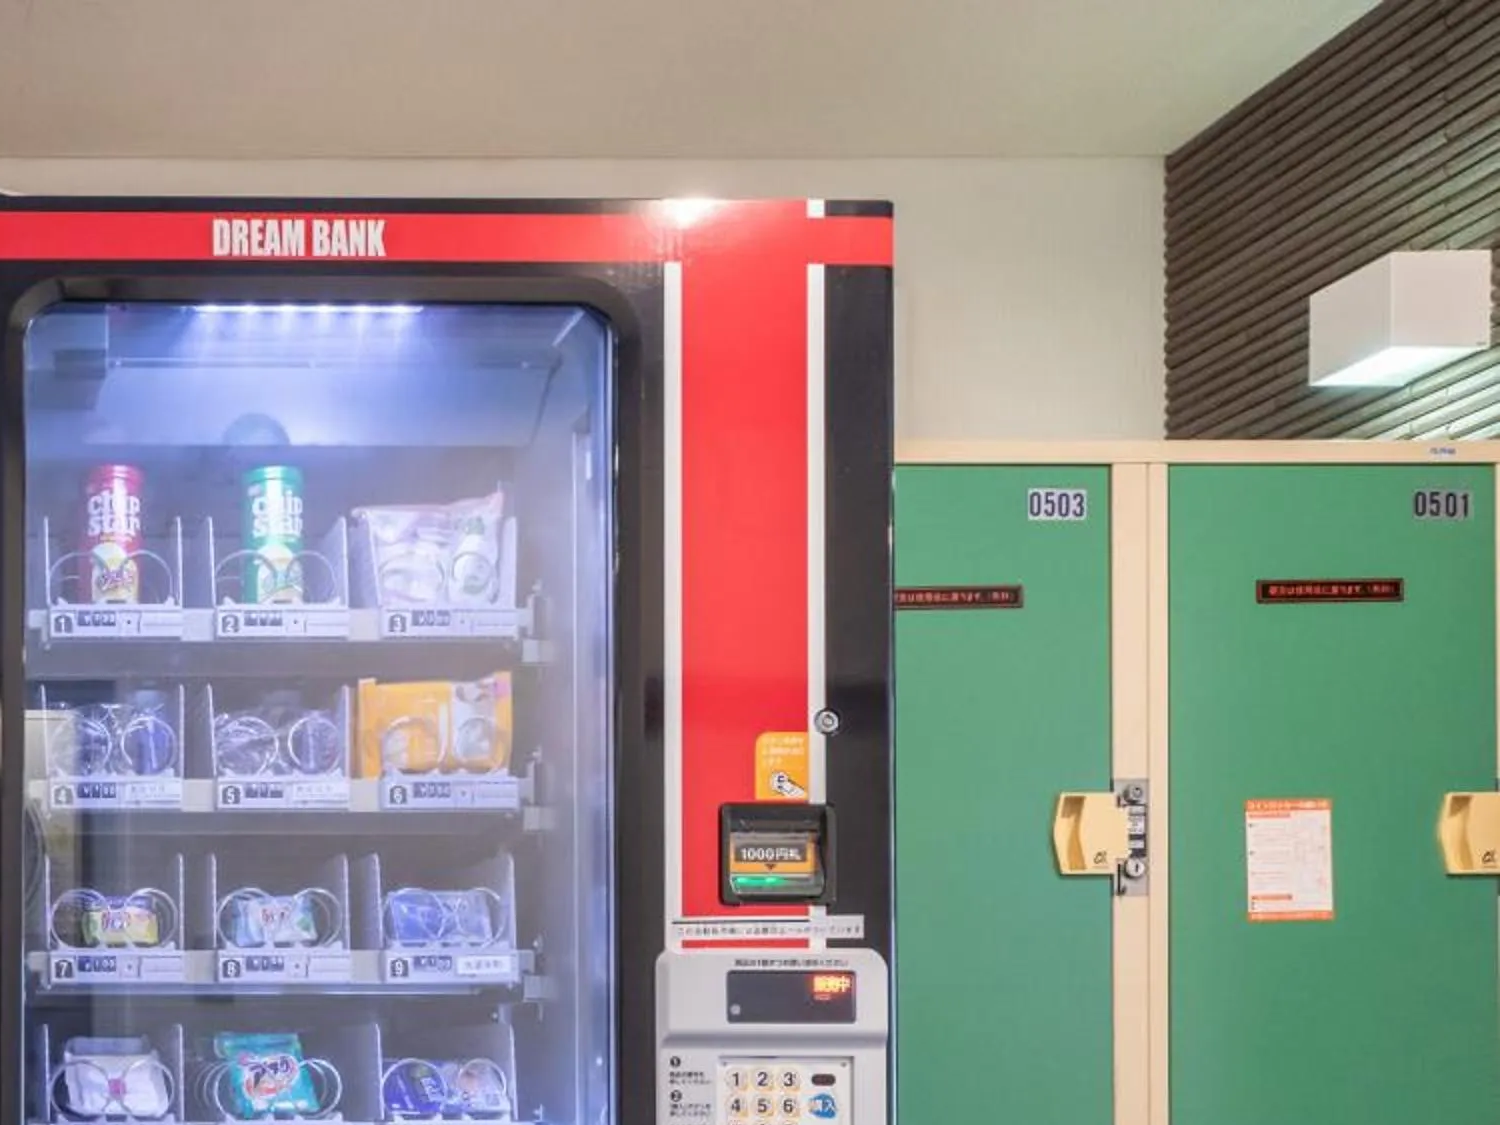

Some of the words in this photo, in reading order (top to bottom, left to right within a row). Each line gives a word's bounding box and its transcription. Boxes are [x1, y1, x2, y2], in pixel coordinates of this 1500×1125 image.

[213, 219, 305, 256] DREAM
[312, 219, 387, 256] BANK
[1030, 491, 1084, 517] 0503
[1415, 491, 1468, 517] 0501
[732, 1072, 740, 1086] 1
[757, 1072, 768, 1086] 2
[783, 1072, 793, 1086] 3
[731, 1099, 741, 1113] 4
[757, 1099, 767, 1113] 5
[783, 1099, 793, 1113] 6
